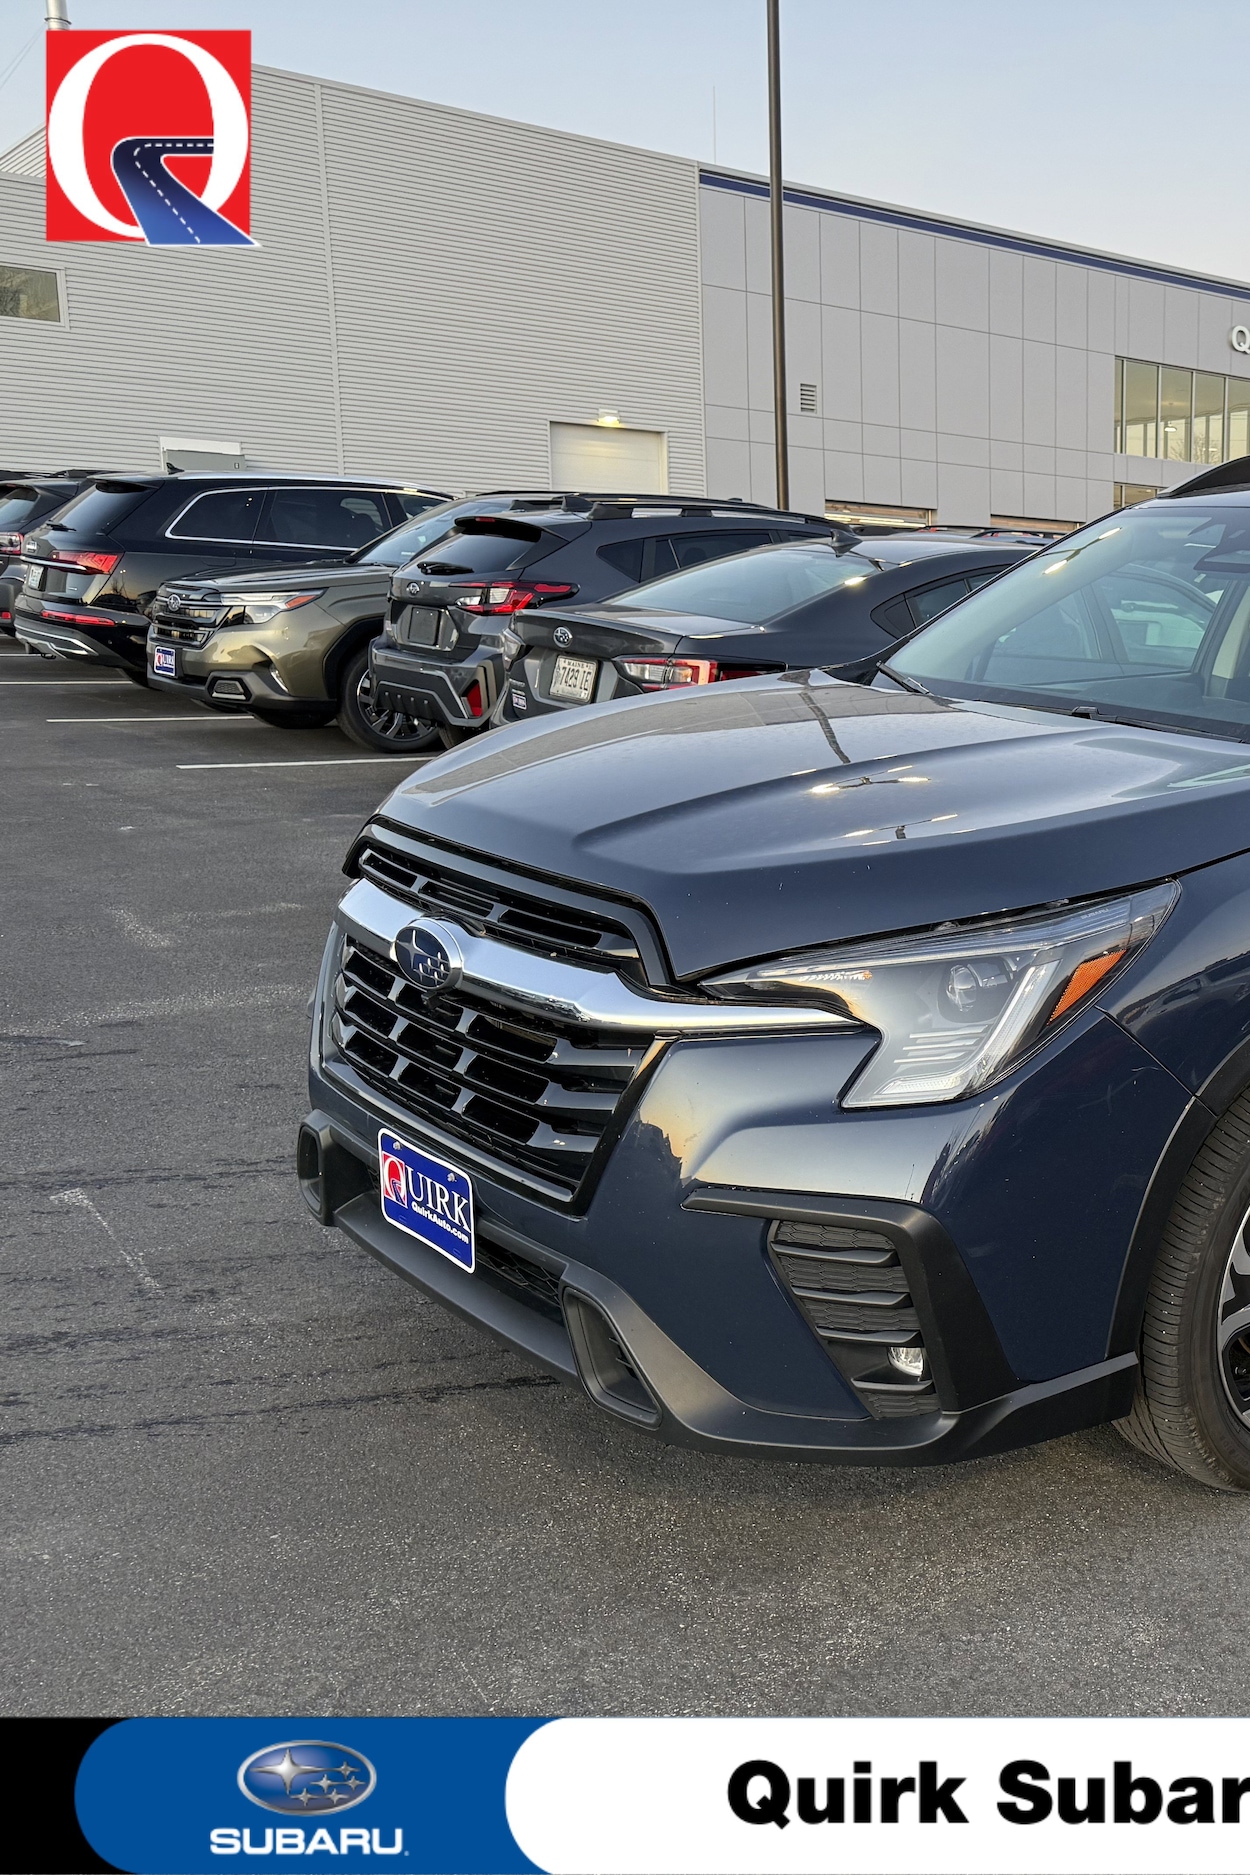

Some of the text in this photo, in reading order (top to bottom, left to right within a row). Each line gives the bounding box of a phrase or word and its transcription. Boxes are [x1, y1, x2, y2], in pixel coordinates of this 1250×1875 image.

[567, 660, 585, 669] MAINE
[383, 1156, 472, 1234] QUIRK
[411, 1201, 470, 1244] QuirkAuto.com
